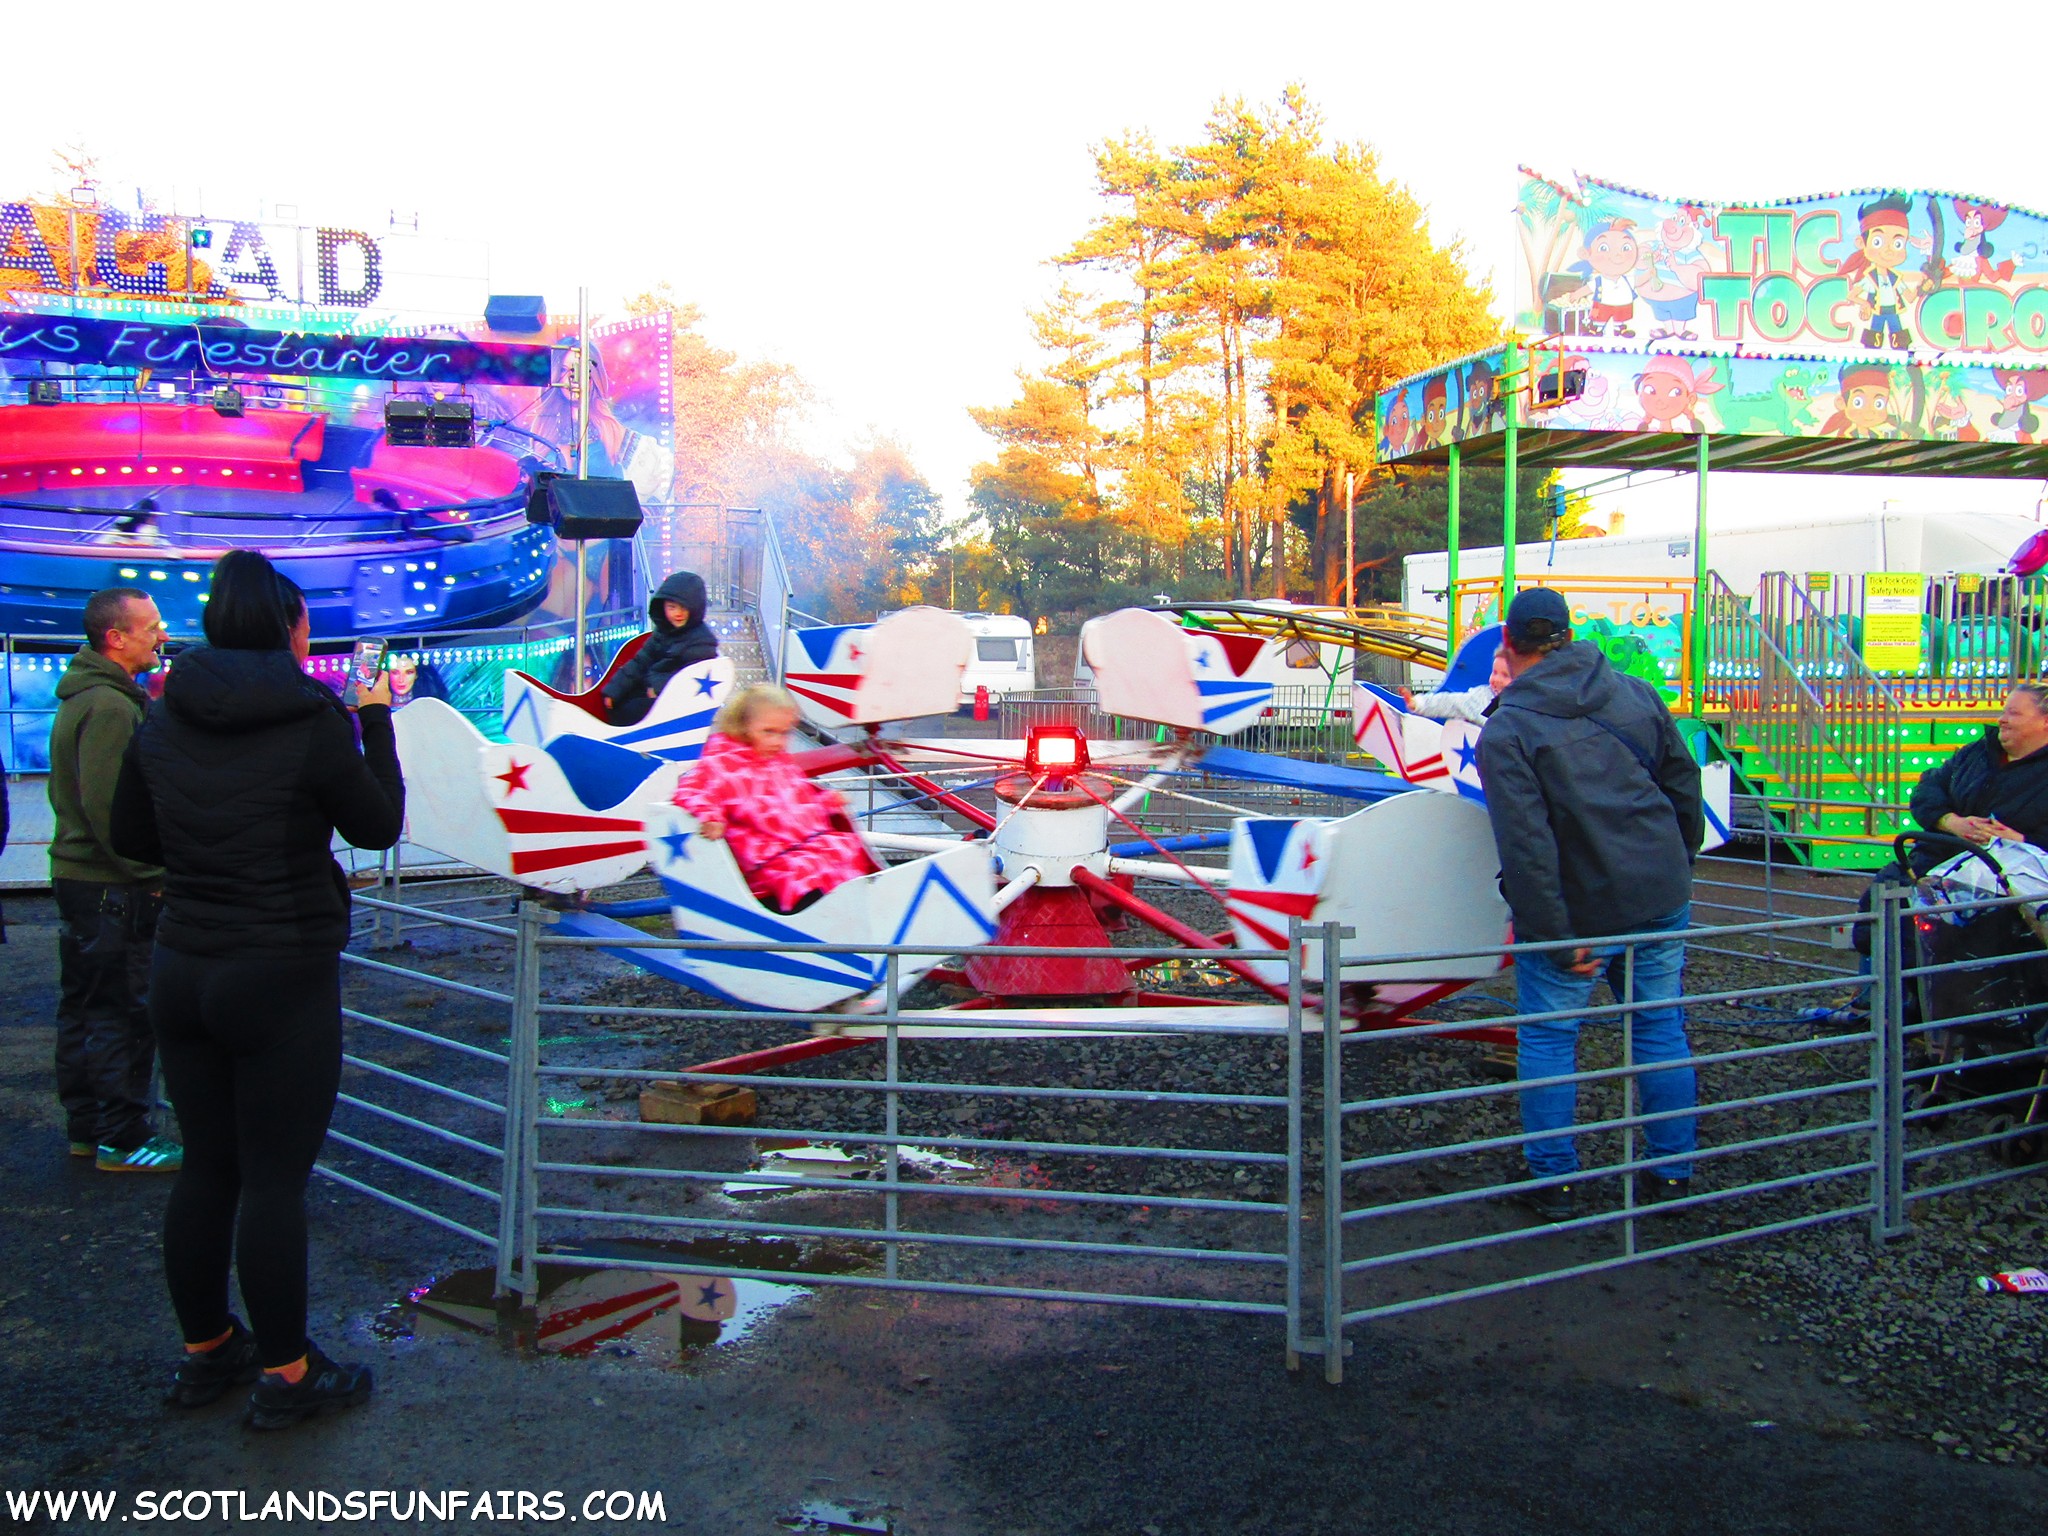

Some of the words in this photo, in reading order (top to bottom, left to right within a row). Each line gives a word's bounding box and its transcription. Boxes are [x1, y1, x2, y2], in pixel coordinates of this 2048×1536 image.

[1712, 208, 1842, 275] TIC
[1698, 272, 1852, 342] TOC
[1915, 283, 2048, 353] CRO
[107, 324, 450, 375] Firestarter
[1871, 587, 1891, 595] Safety
[1893, 587, 1915, 595] Notice
